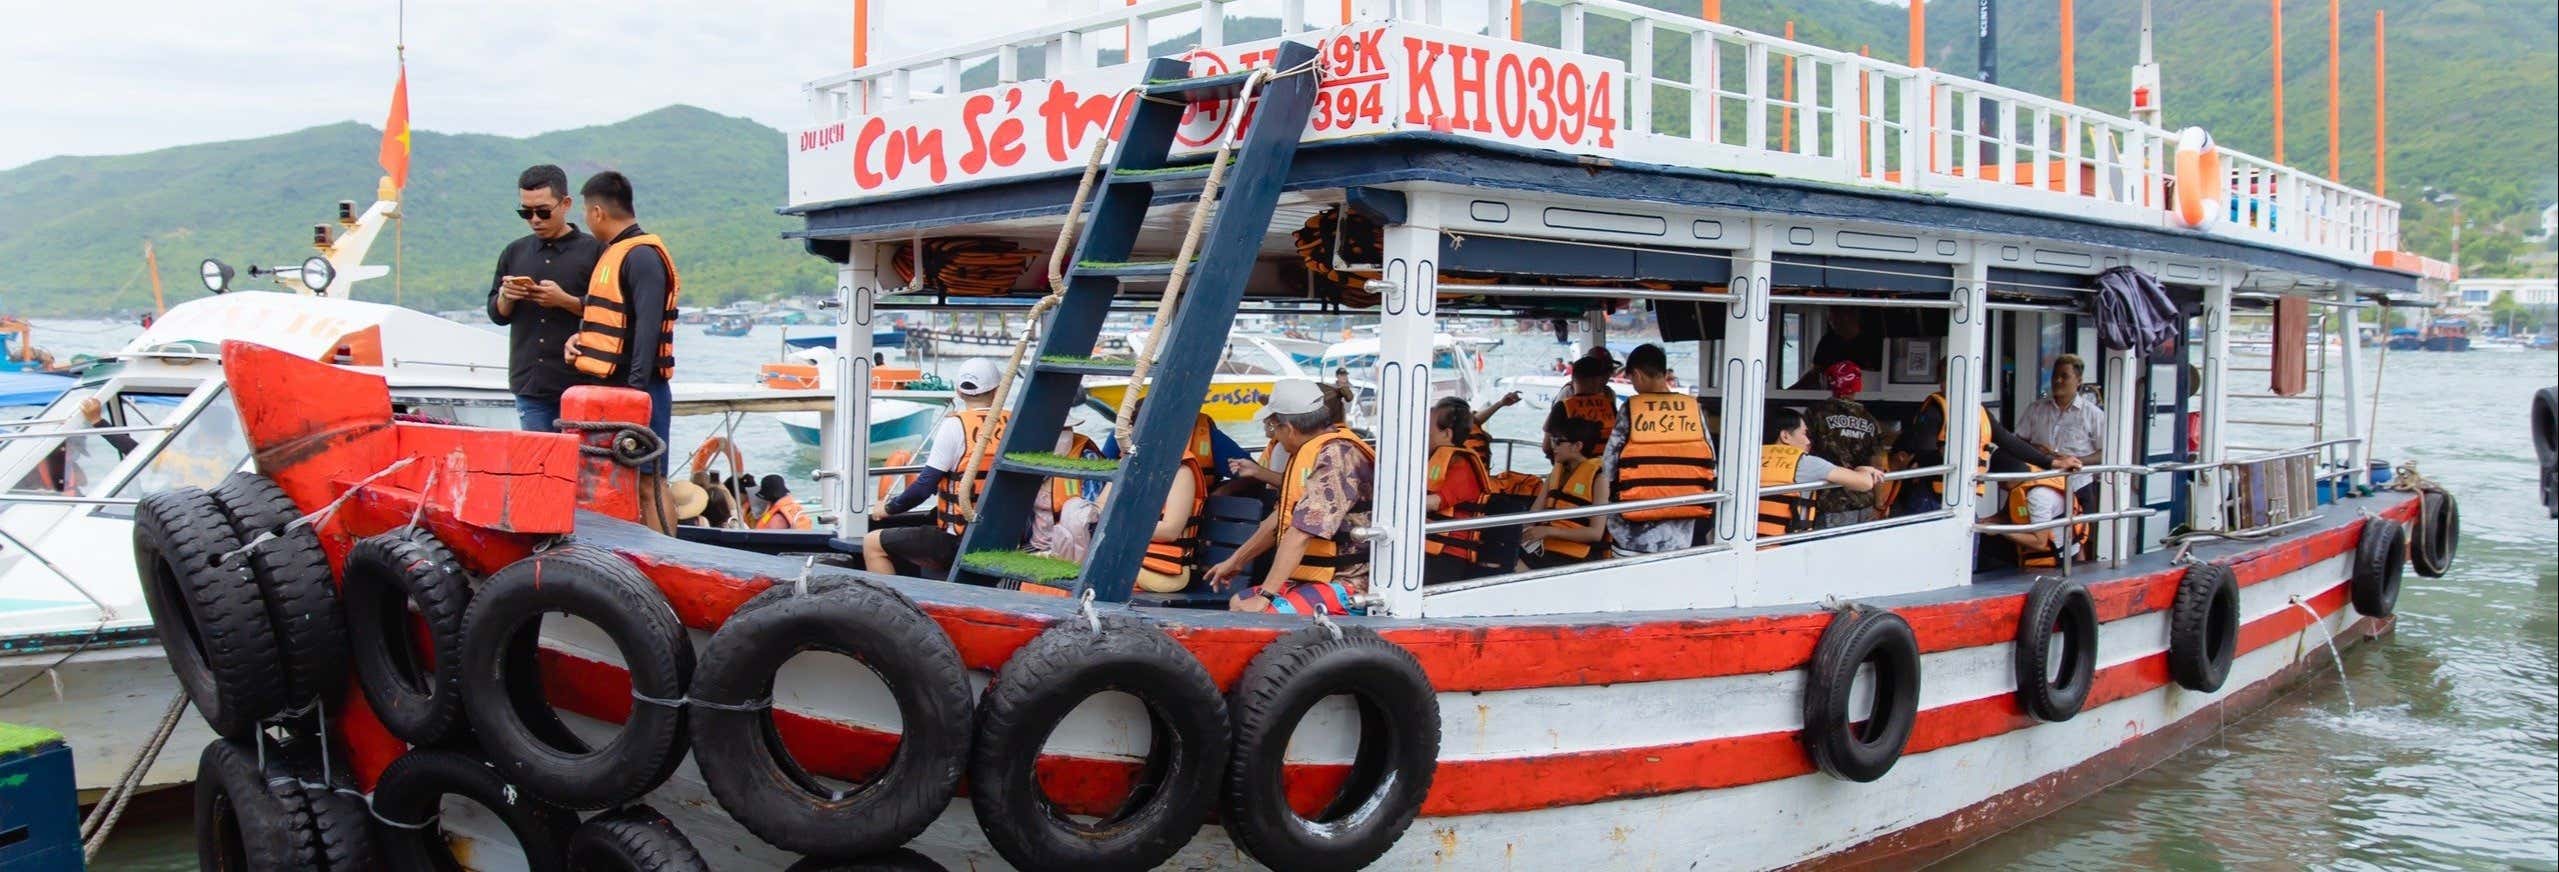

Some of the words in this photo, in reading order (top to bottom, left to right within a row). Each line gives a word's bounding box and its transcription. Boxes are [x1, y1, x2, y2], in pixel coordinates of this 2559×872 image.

[1403, 36, 1616, 149] KH0394
[854, 116, 947, 190] Con
[1643, 400, 1685, 411] TAU
[1635, 413, 1656, 432] Con
[1678, 415, 1697, 432] Tre
[1826, 415, 1875, 437] KOREA
[1840, 428, 1866, 439] ARMY
